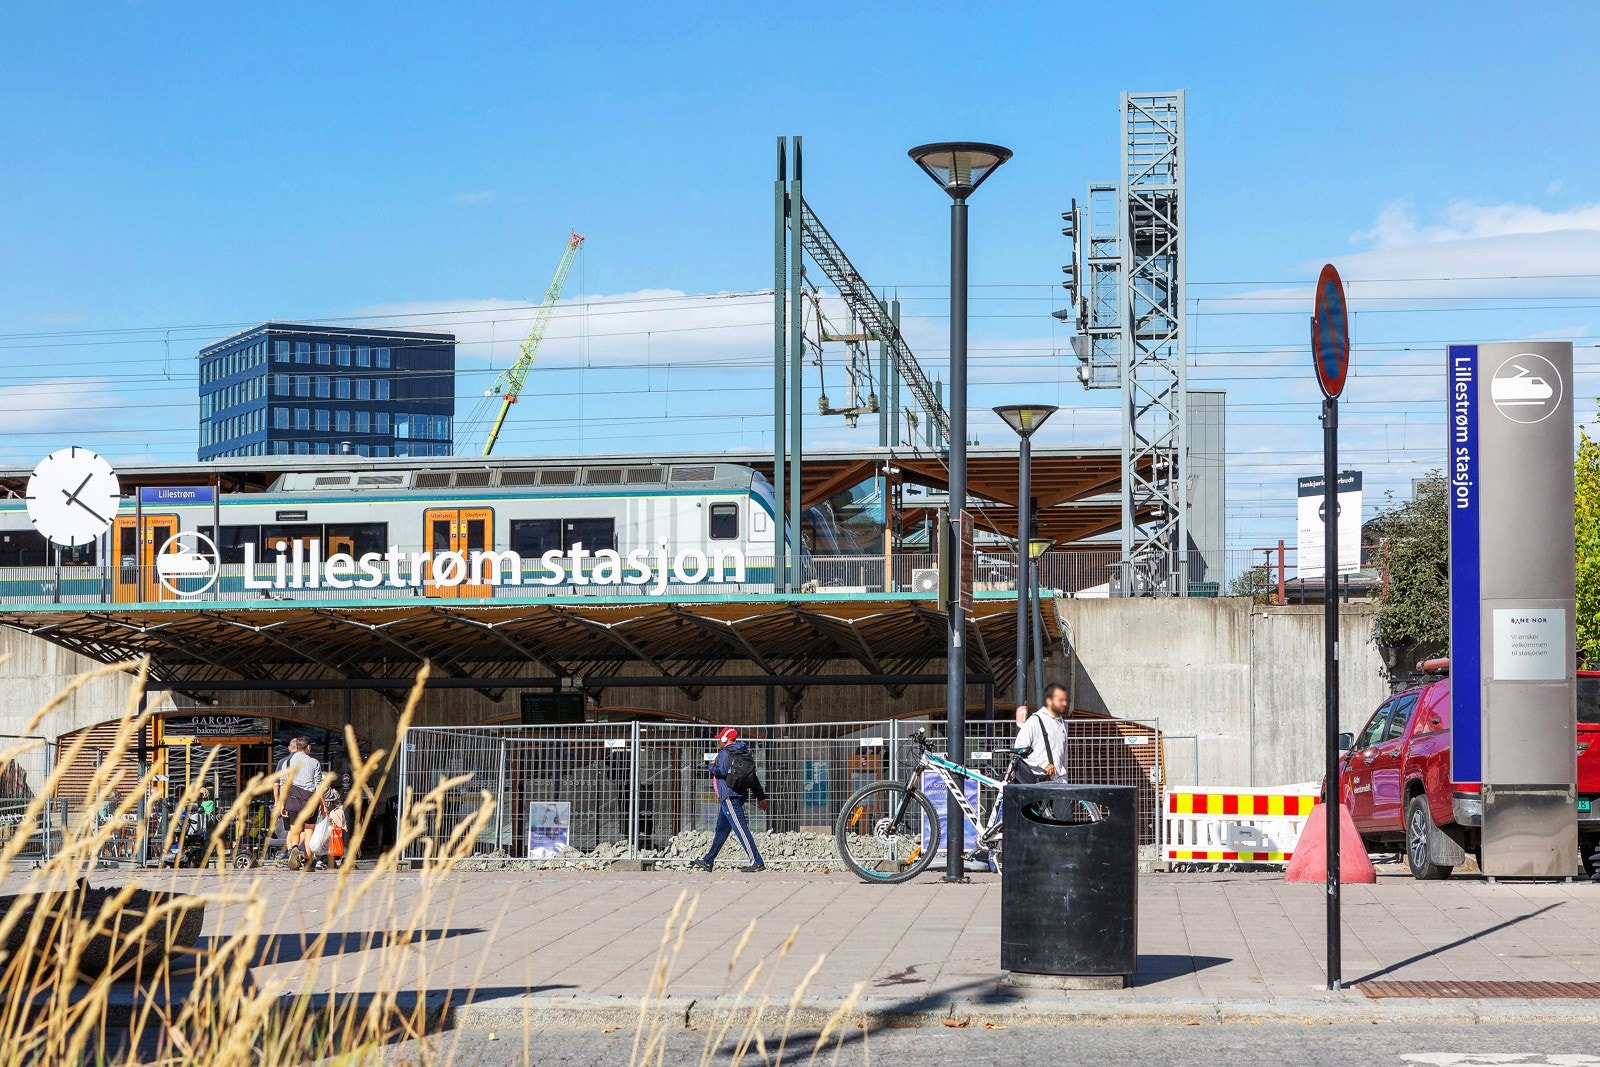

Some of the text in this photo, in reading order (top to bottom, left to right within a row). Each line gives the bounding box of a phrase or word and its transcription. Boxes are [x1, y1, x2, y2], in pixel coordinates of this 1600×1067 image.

[1452, 357, 1473, 509] Lillestrøm stasjon
[158, 489, 196, 499] Lillestrøm
[244, 535, 745, 596] Lillestrøm stasjon
[191, 716, 240, 726] GARÇON
